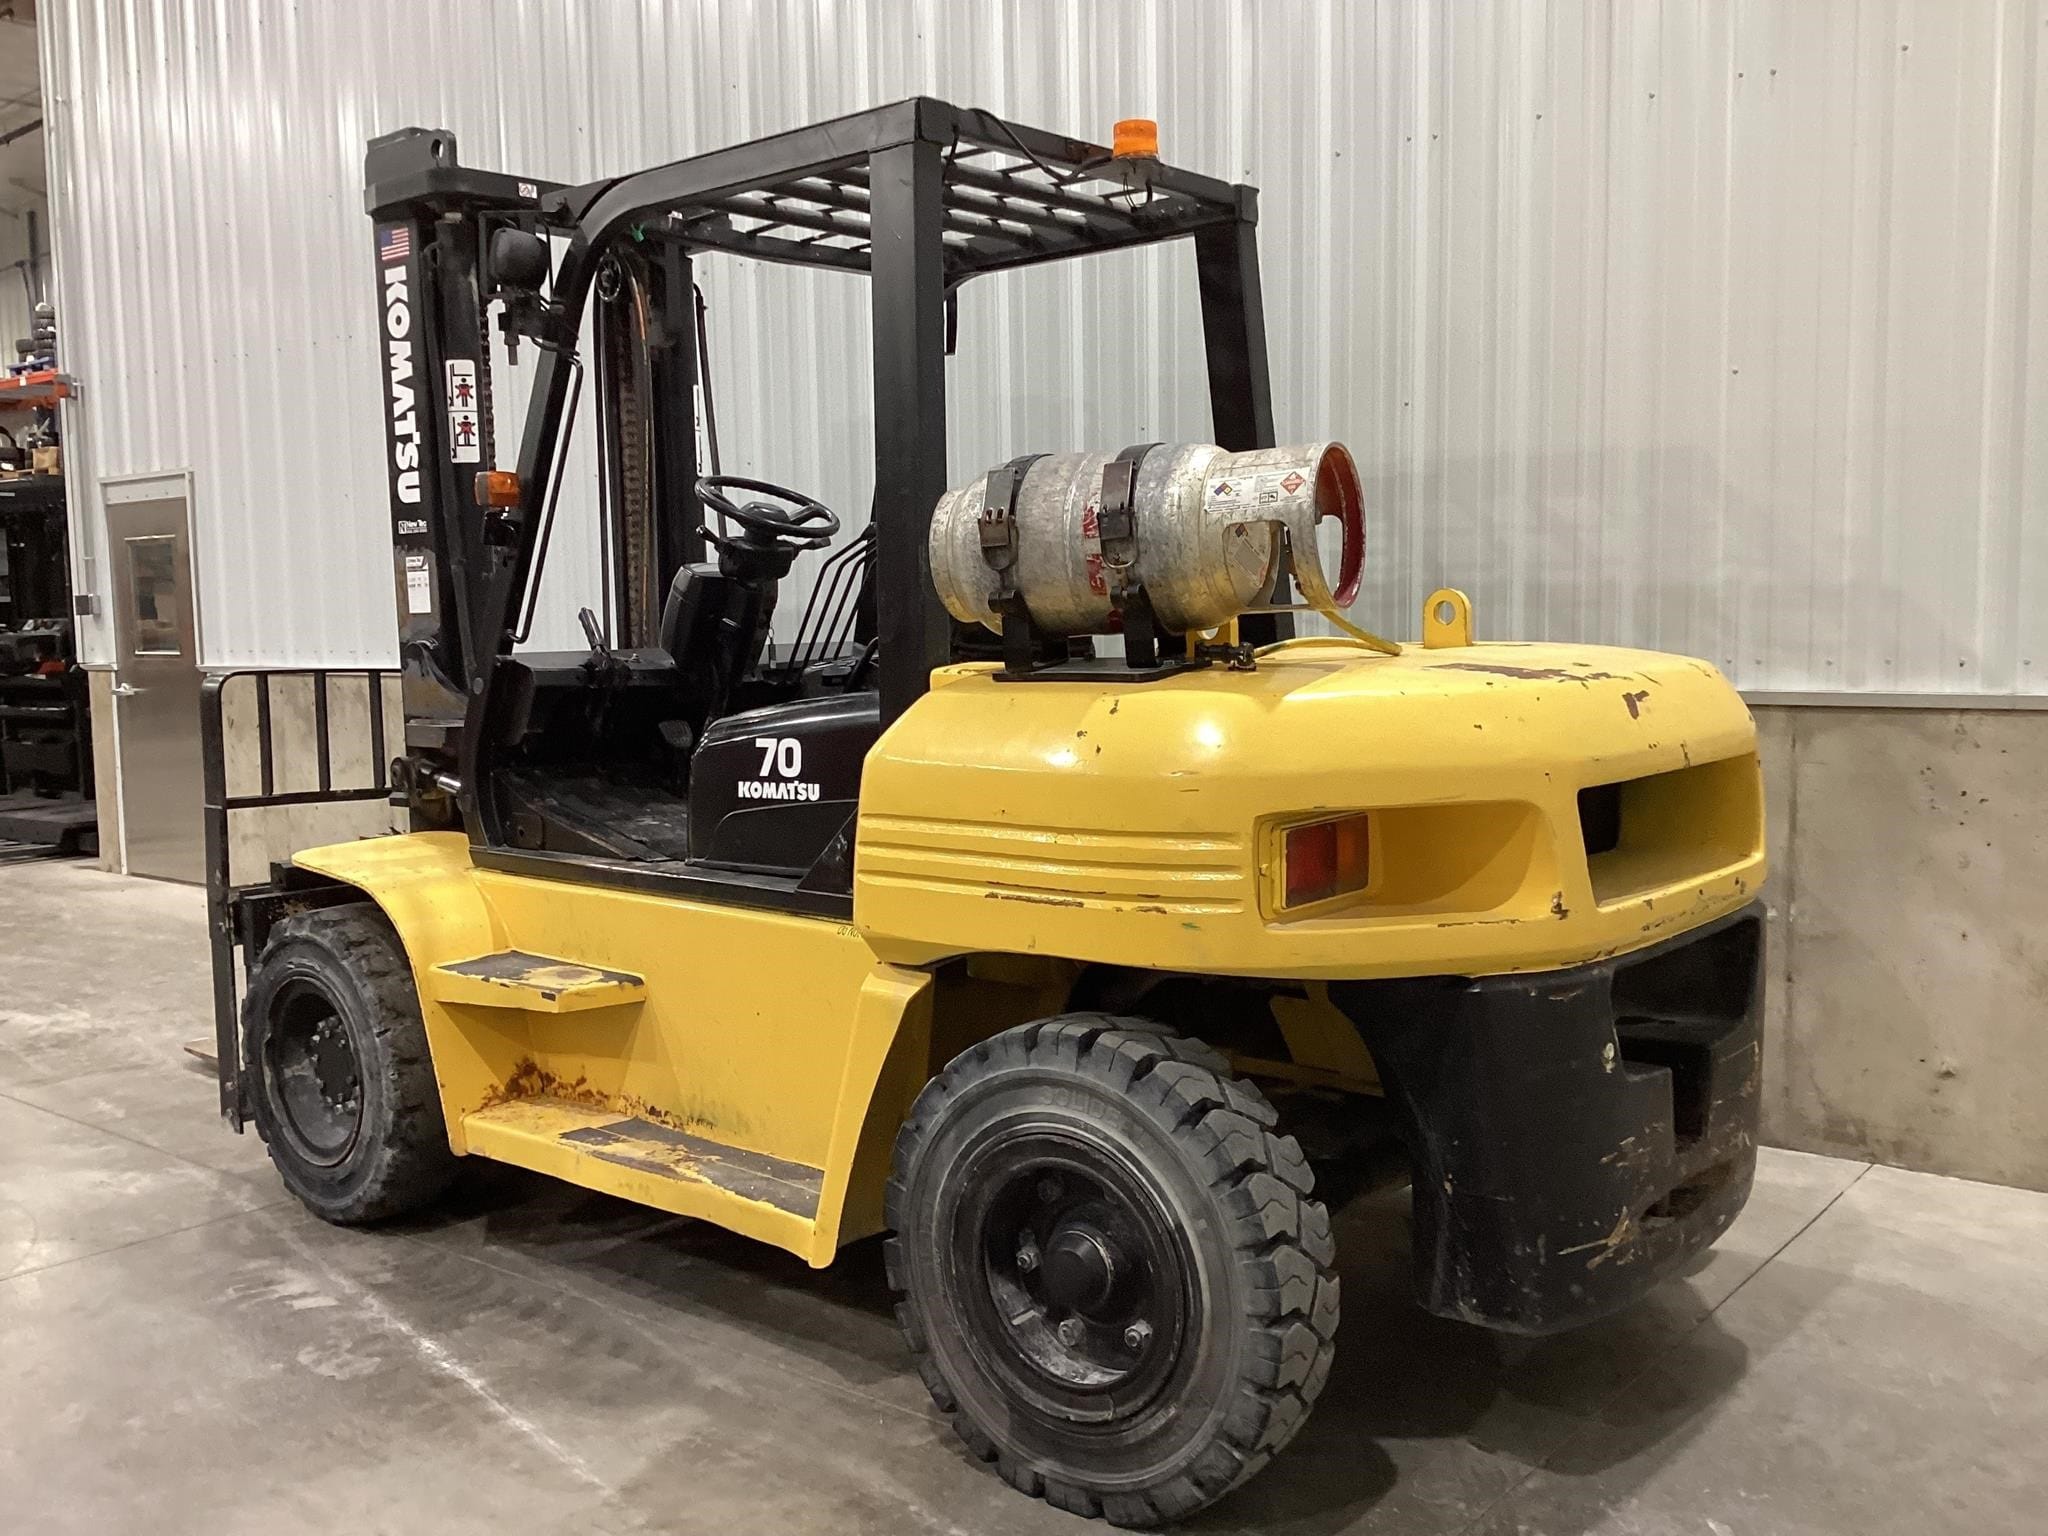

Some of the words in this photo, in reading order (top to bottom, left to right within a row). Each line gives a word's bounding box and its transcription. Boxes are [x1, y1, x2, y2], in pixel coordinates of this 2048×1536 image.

[385, 265, 421, 503] KOMATSU
[755, 737, 802, 778] 70
[738, 780, 820, 801] KOMATSU
